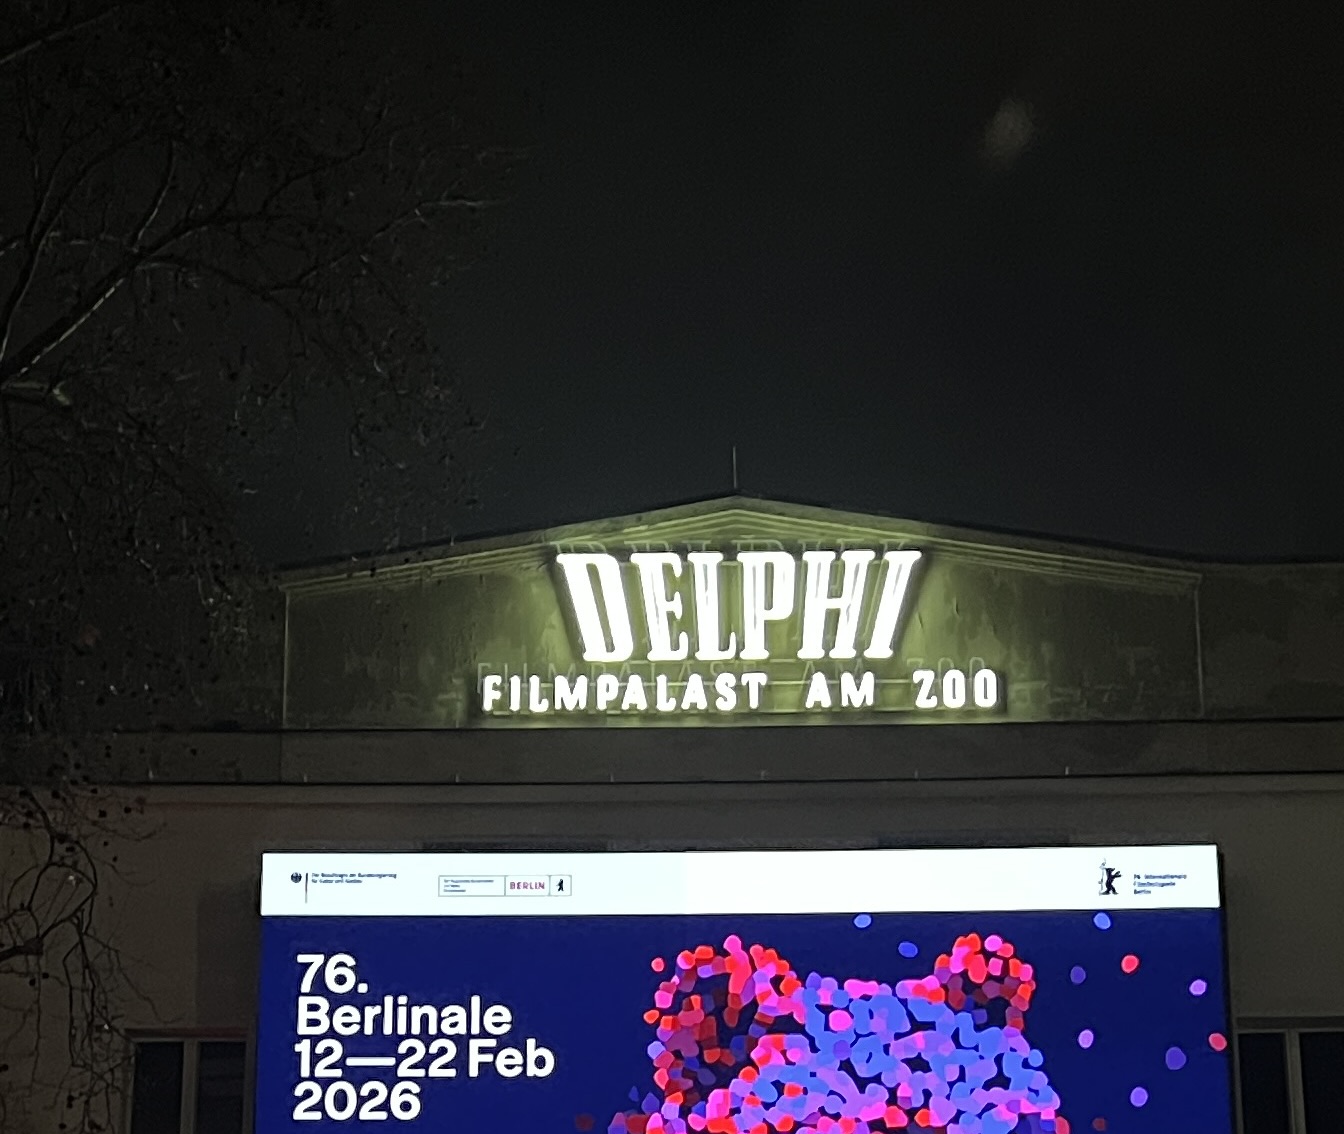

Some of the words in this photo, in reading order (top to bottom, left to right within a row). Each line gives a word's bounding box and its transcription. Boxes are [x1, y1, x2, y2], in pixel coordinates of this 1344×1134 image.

[555, 549, 923, 663] DELPHI
[481, 671, 769, 713] FILMPALAST
[805, 671, 876, 709] AM
[911, 668, 999, 709] ZOO
[508, 880, 546, 890] BERLIN
[296, 953, 369, 994] 76.
[296, 994, 513, 1036] Berlinale
[467, 1037, 556, 1078] Feb
[292, 1080, 422, 1121] 2026
